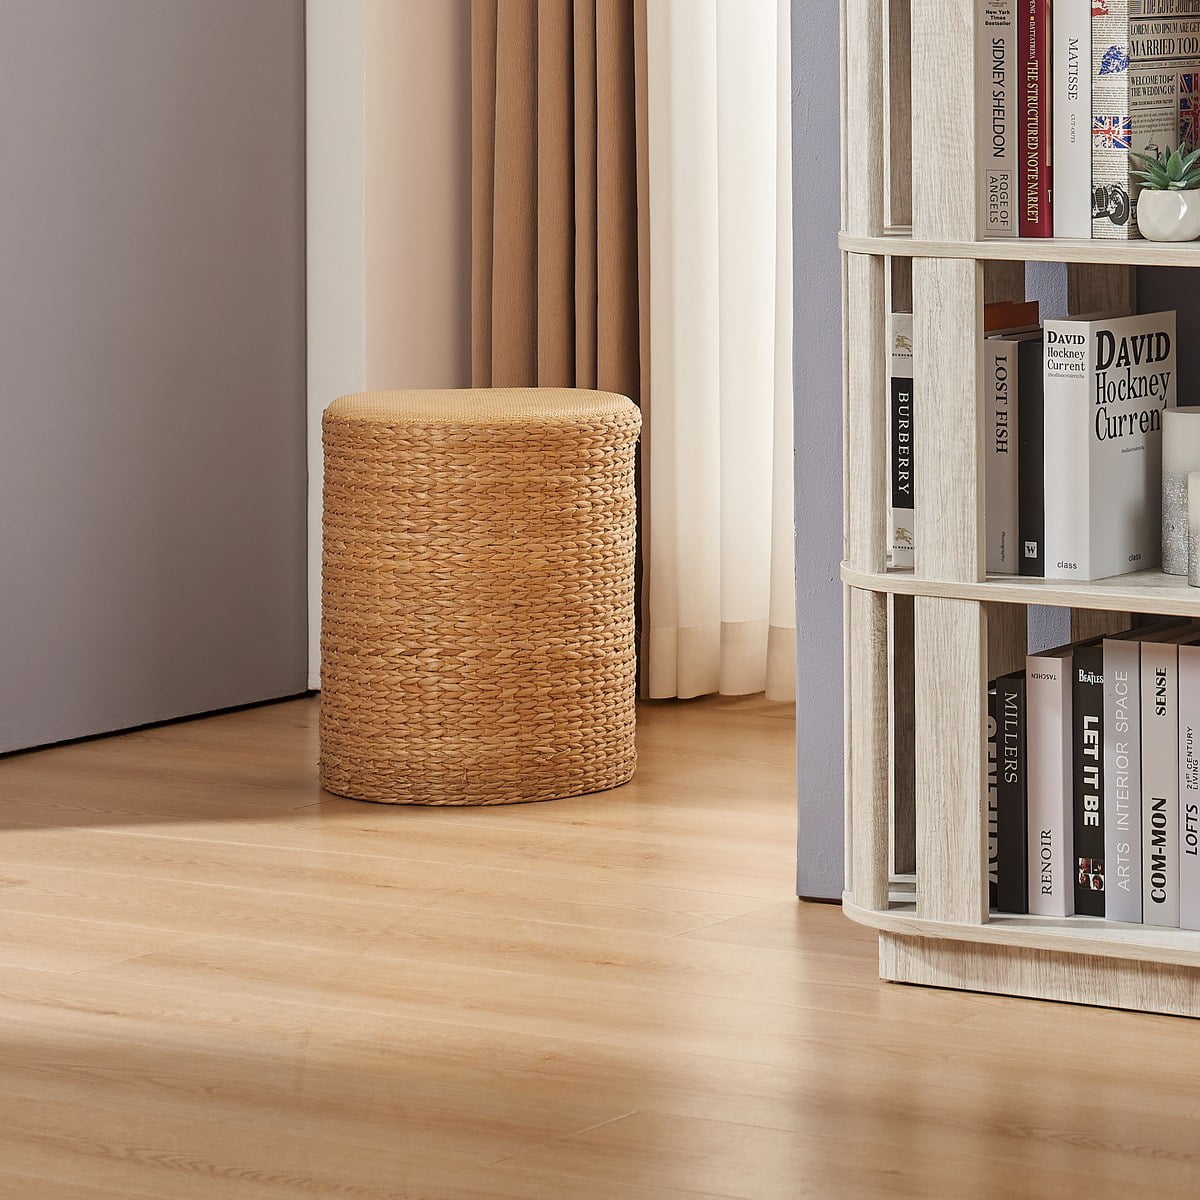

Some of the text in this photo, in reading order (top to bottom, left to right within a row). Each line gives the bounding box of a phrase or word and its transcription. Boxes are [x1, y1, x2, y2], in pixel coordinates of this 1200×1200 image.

[1131, 38, 1175, 56] MARRIED
[1027, 59, 1039, 81] THE
[1068, 37, 1079, 101] MATISSE
[1131, 75, 1159, 86] WELCOME
[992, 38, 1005, 158] SIDNEY SHELDON
[1131, 87, 1141, 97] THE
[1142, 86, 1166, 96] WEDDING
[1026, 83, 1039, 150] STRUCTURED
[1027, 151, 1039, 180] NOTE
[989, 175, 998, 223] ANGELS
[1000, 210, 1008, 226] OF
[1047, 331, 1085, 345] DAVID
[1047, 347, 1085, 360] Hockney
[1095, 330, 1171, 371] DAVID
[1047, 359, 1085, 371] Current
[995, 355, 1009, 454] LOST FISH
[1095, 367, 1171, 405] Hockney
[1095, 400, 1167, 441] Curren
[898, 392, 910, 494] BURBERRY
[1026, 545, 1036, 554] W
[1057, 561, 1078, 570] class
[1128, 553, 1142, 562] class
[1031, 672, 1057, 680] TASCHEN
[1004, 692, 1018, 784] MILLERS
[1083, 715, 1100, 826] LET IT BE
[1115, 670, 1130, 892] ARTS INTERIOR SPACE
[1151, 667, 1167, 904] COM-MON SENSE
[1186, 804, 1198, 856] LOFTS
[1041, 829, 1052, 896] RENOIR
